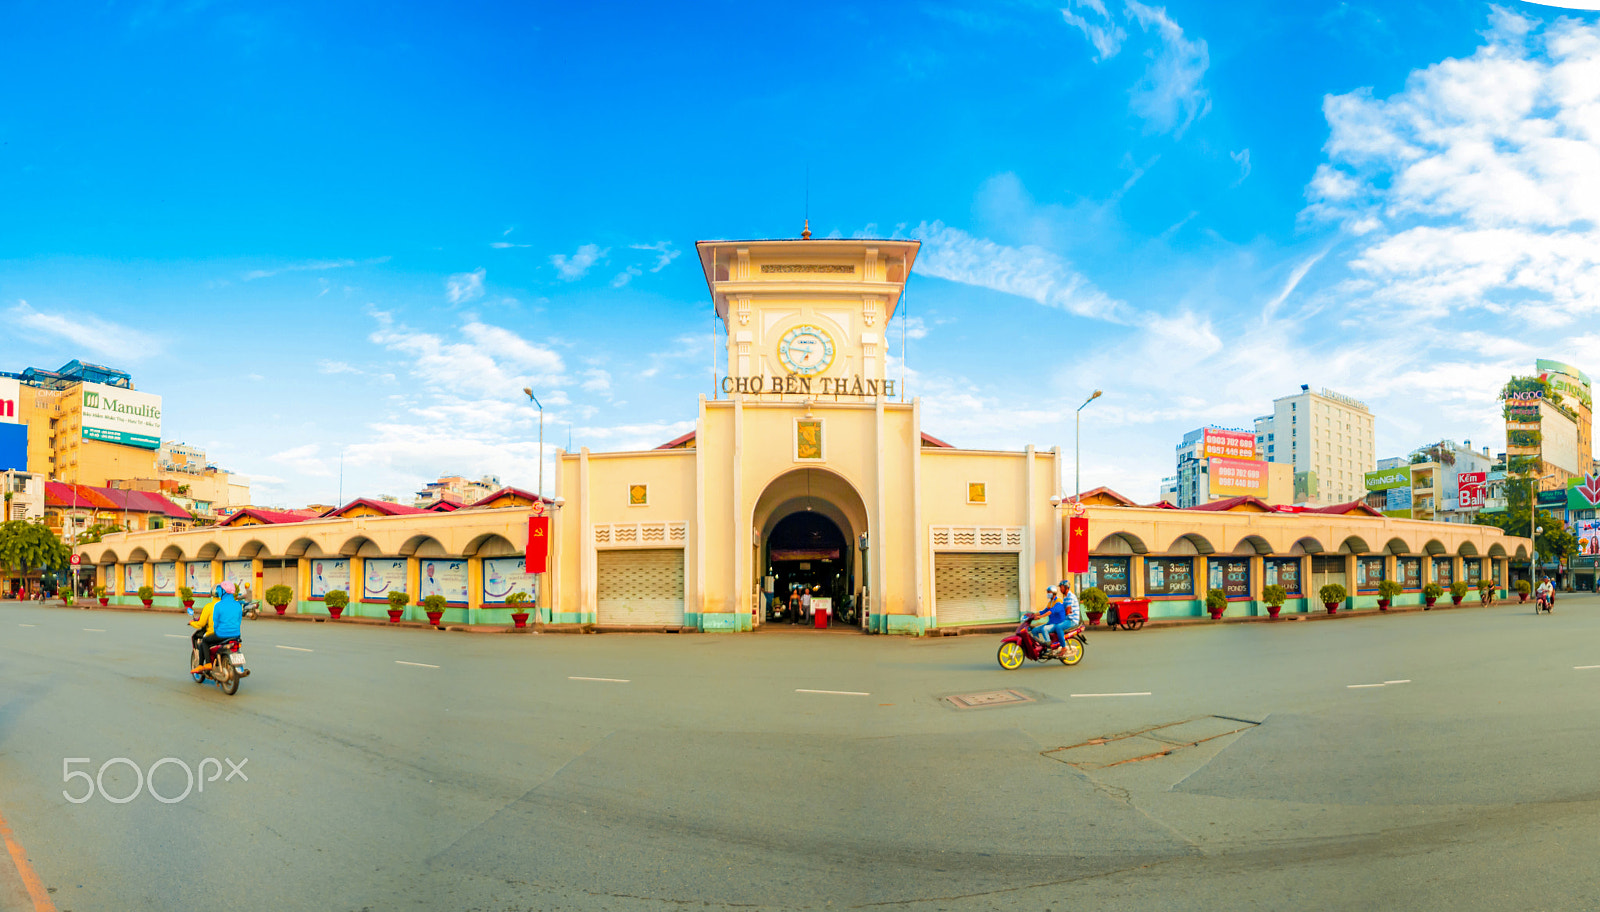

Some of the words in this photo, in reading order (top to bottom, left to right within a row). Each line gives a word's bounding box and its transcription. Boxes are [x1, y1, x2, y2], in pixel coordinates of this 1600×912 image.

[722, 375, 763, 395] CHỢ
[820, 374, 896, 396] THÀNH
[102, 397, 160, 419] Manulife
[1104, 564, 1110, 572] 3
[1170, 564, 1174, 572] 3
[1228, 564, 1232, 572] 3
